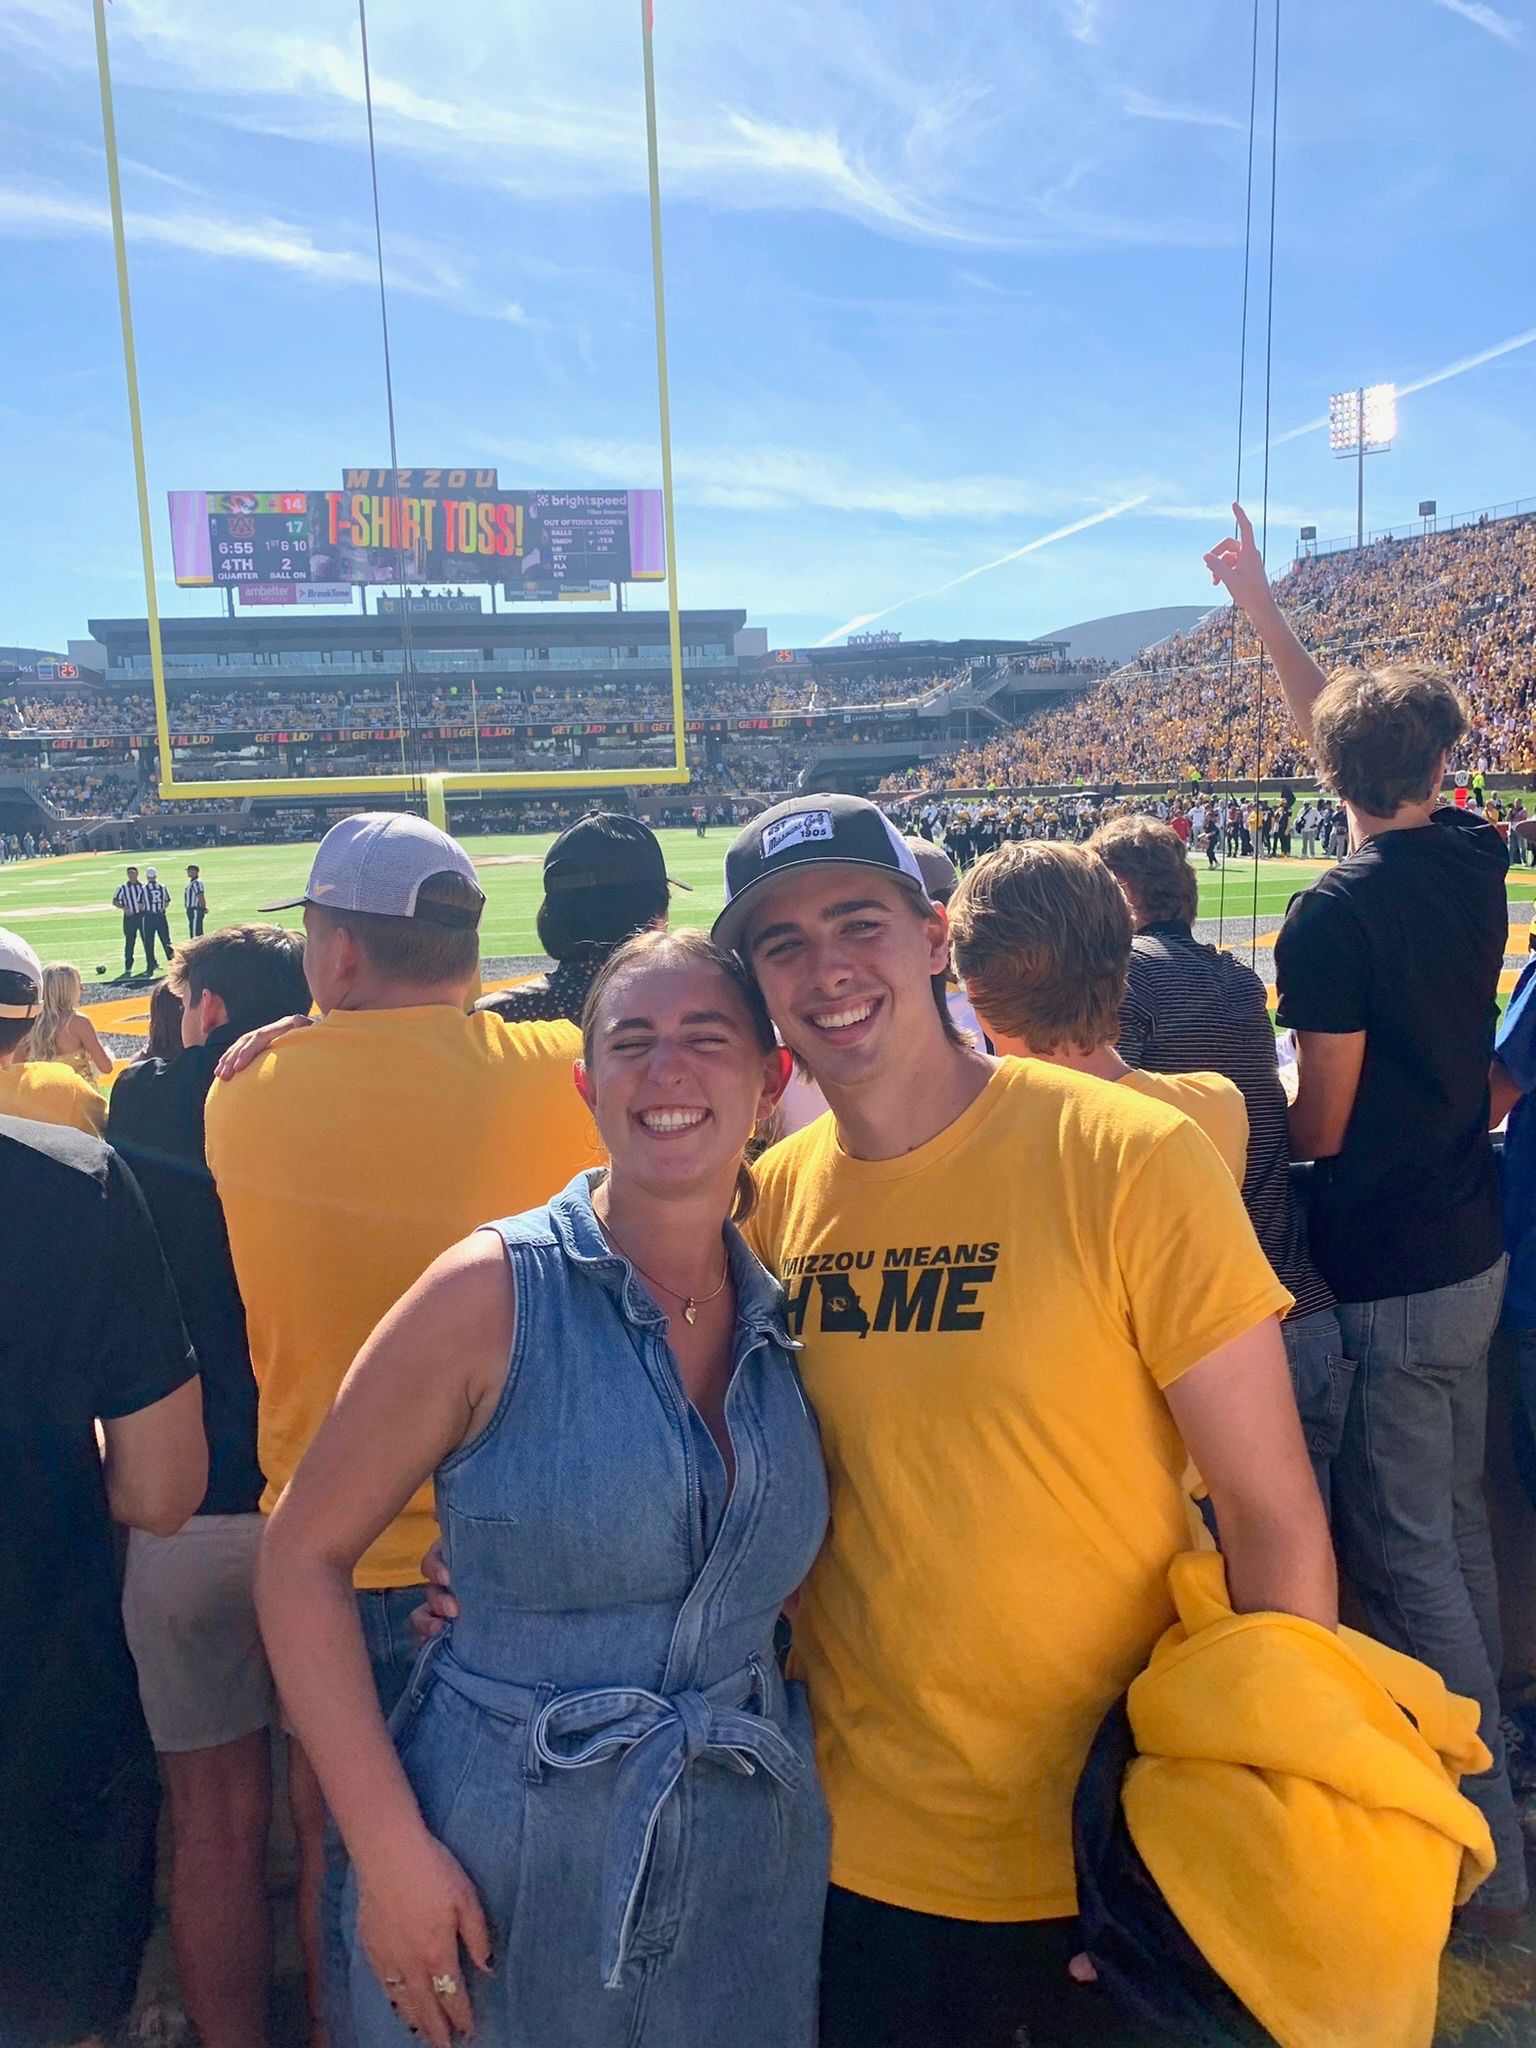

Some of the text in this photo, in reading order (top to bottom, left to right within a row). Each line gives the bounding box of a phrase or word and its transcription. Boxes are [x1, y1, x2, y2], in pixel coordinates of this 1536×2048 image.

[346, 470, 495, 488] MIZZOU
[284, 498, 302, 510] 14
[551, 495, 626, 509] brightspeed
[286, 521, 303, 533] 17
[325, 493, 523, 556] T-SHIRT TOSS!
[218, 542, 253, 554] 6:55
[293, 540, 307, 551] 10
[221, 559, 253, 571] 4TH
[281, 558, 292, 570] 2
[218, 572, 258, 580] QUARTER
[245, 586, 288, 596] ambetter
[447, 600, 477, 611] Care
[778, 651, 791, 660] 25
[61, 666, 76, 677] 25
[154, 736, 175, 746] GT
[768, 820, 786, 836] EST
[800, 828, 827, 838] 1905
[151, 889, 162, 902] R
[783, 1242, 1000, 1277] MIZZOU MEANS
